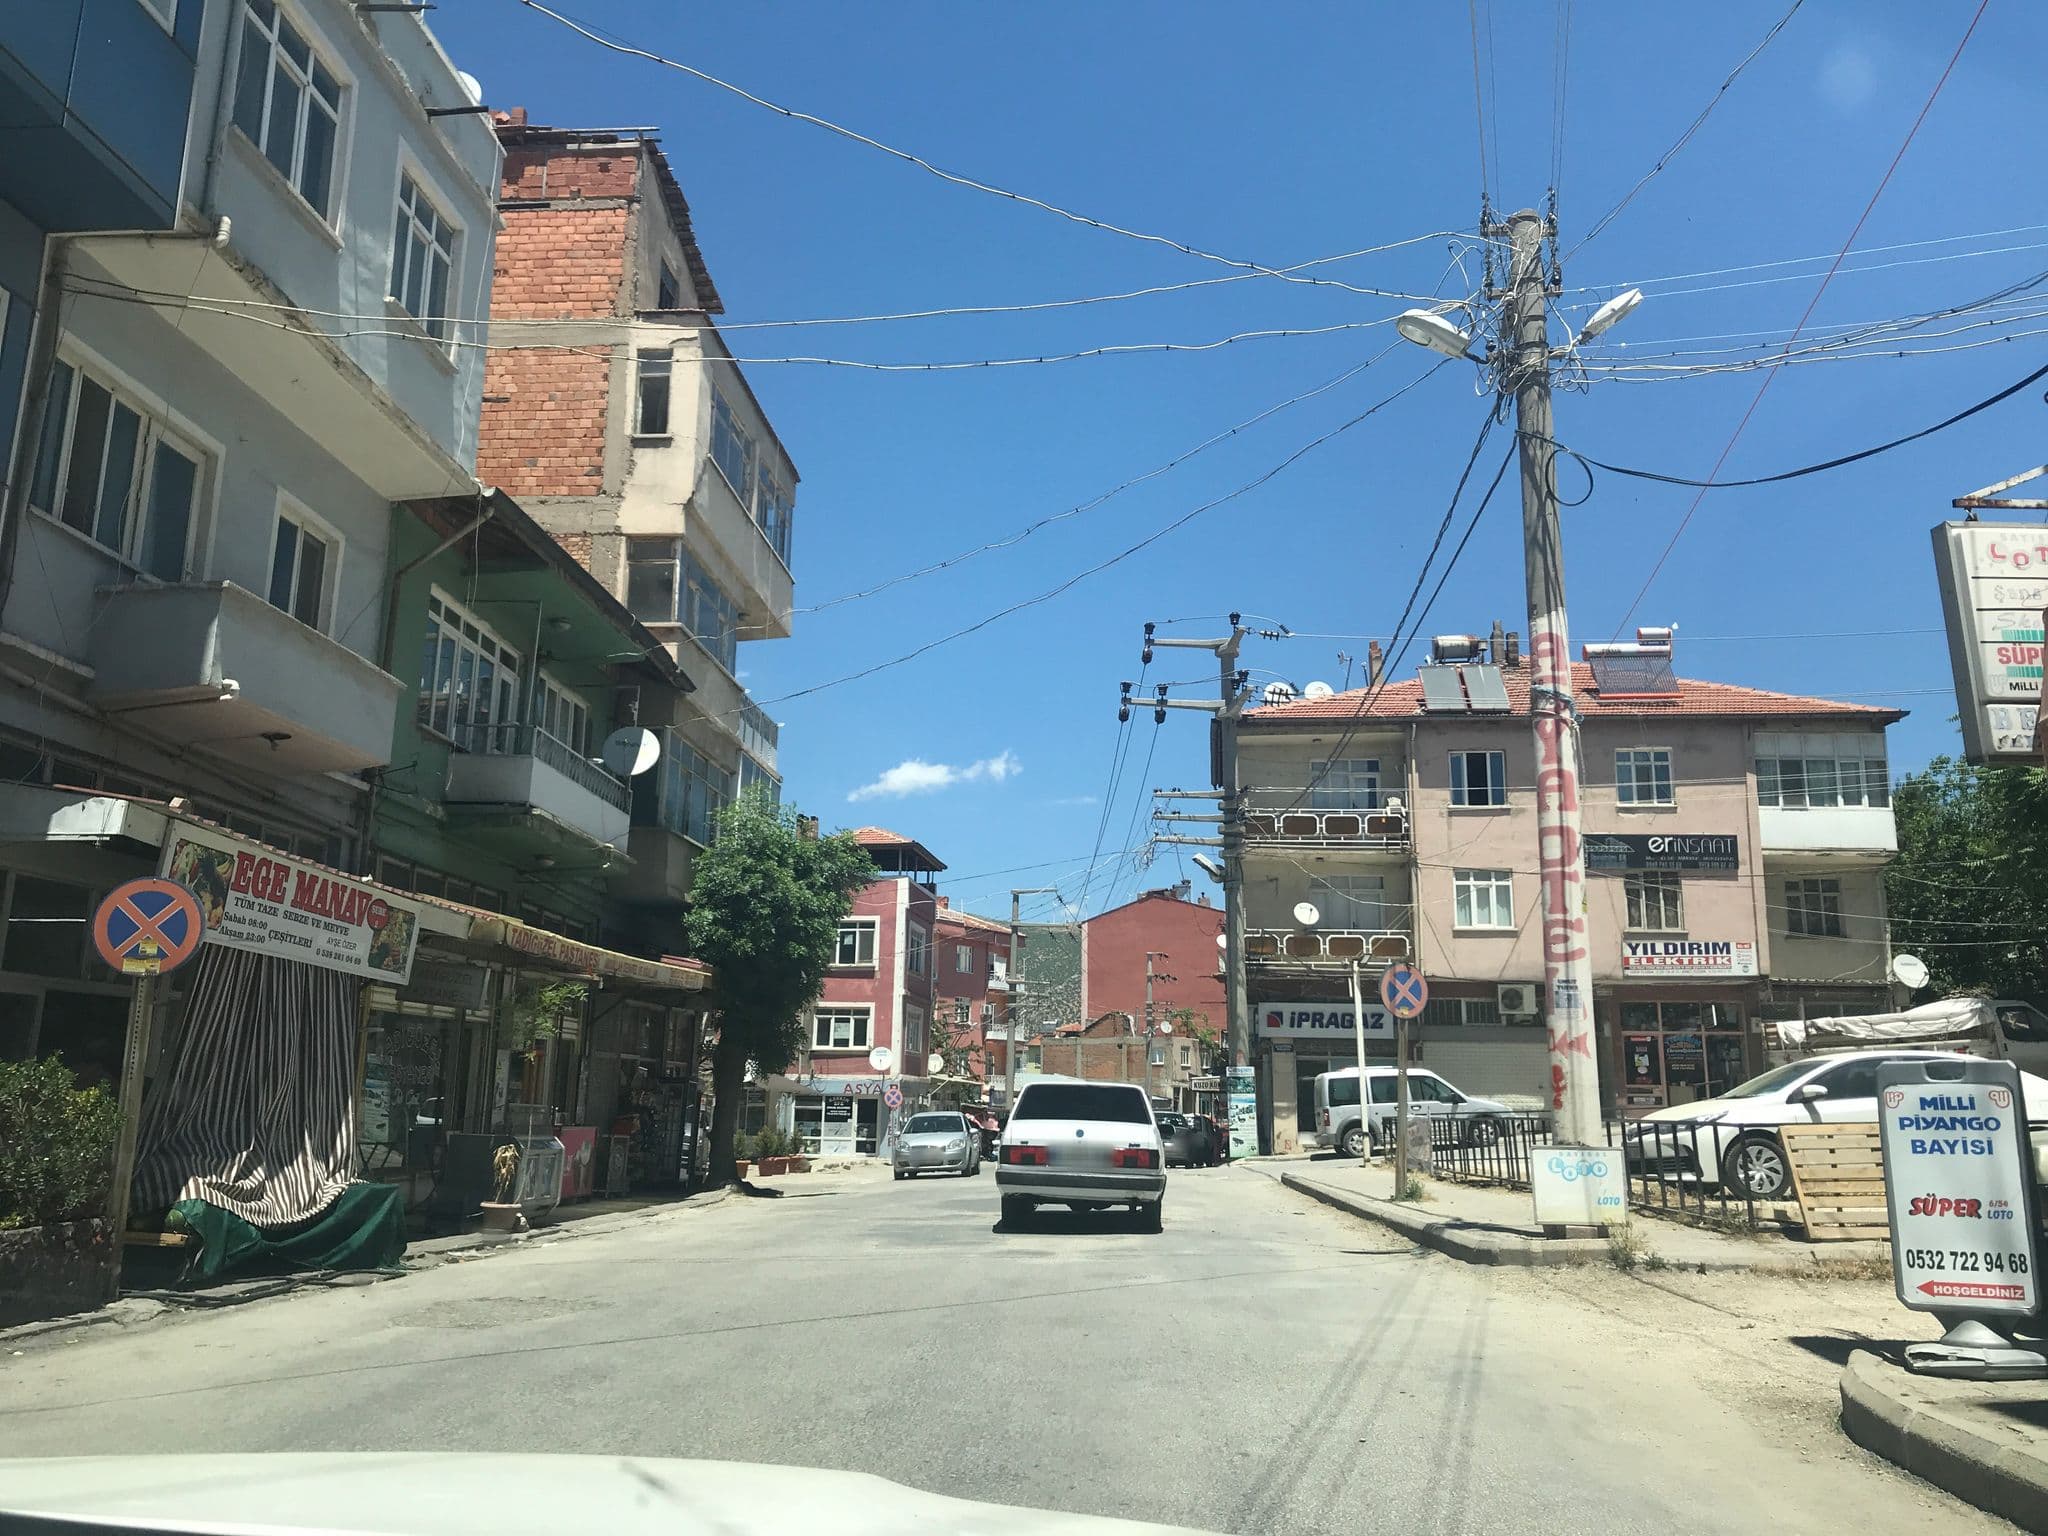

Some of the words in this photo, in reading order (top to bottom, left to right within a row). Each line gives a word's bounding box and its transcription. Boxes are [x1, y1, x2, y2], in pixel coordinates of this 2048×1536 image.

[230, 850, 291, 905] EGE
[291, 870, 373, 927] MANAV
[224, 911, 246, 925] Sabah
[234, 896, 255, 909] TÜM
[258, 903, 279, 917] TAZE
[283, 910, 310, 926] SEBZE
[311, 918, 322, 928] VE
[324, 922, 350, 936] MEYVE
[218, 925, 244, 938] Akşam
[268, 928, 313, 948] ÇEŞİTLERİ
[326, 936, 341, 947] AYŞE
[1627, 942, 1731, 956] YILDIRIM
[844, 1083, 882, 1096] ASYA
[1920, 1094, 1976, 1111] MİLLİ
[1899, 1113, 2001, 1131] PİYANGO
[1911, 1136, 1994, 1155] BAYİSİ
[1598, 1196, 1620, 1206] LOTO
[1908, 1192, 1982, 1219] SÜPER
[1987, 1209, 2014, 1220] LOTO
[1906, 1248, 1945, 1270] 0532
[1950, 1250, 1979, 1272] 722
[1984, 1252, 2005, 1273] 94
[2007, 1253, 2029, 1274] 68
[1933, 1284, 2024, 1300] HOŞGELDİNİZ
